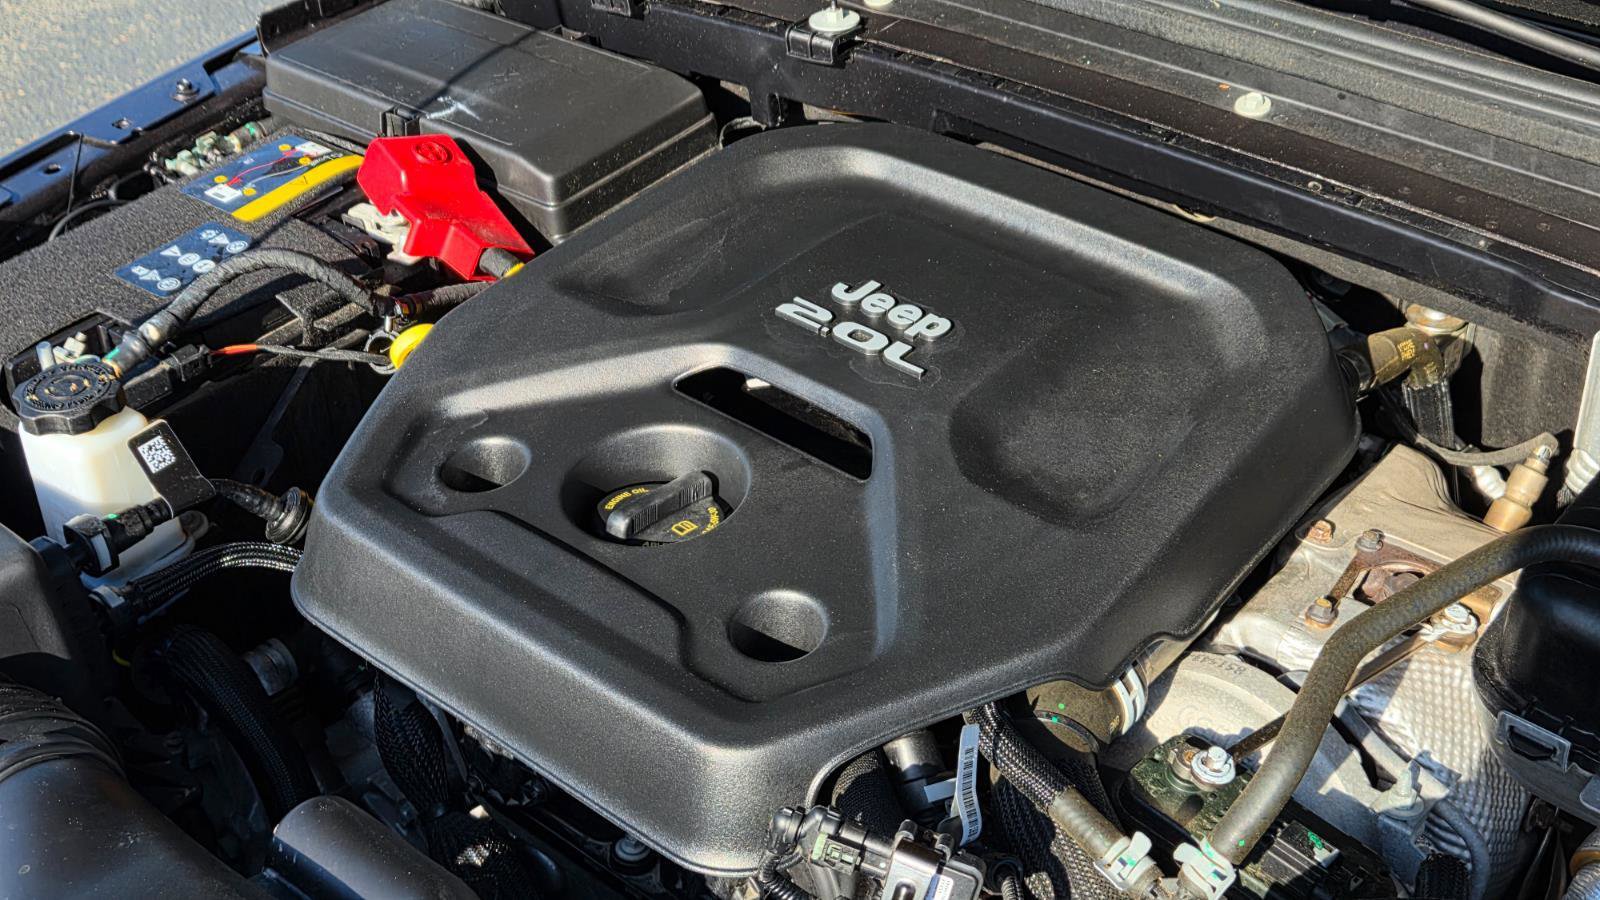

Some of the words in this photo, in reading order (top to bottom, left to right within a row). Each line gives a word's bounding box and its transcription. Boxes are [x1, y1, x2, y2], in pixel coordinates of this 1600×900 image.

[775, 296, 925, 380] 2.0L
[831, 280, 953, 342] Jeep
[605, 491, 632, 509] ENGINE
